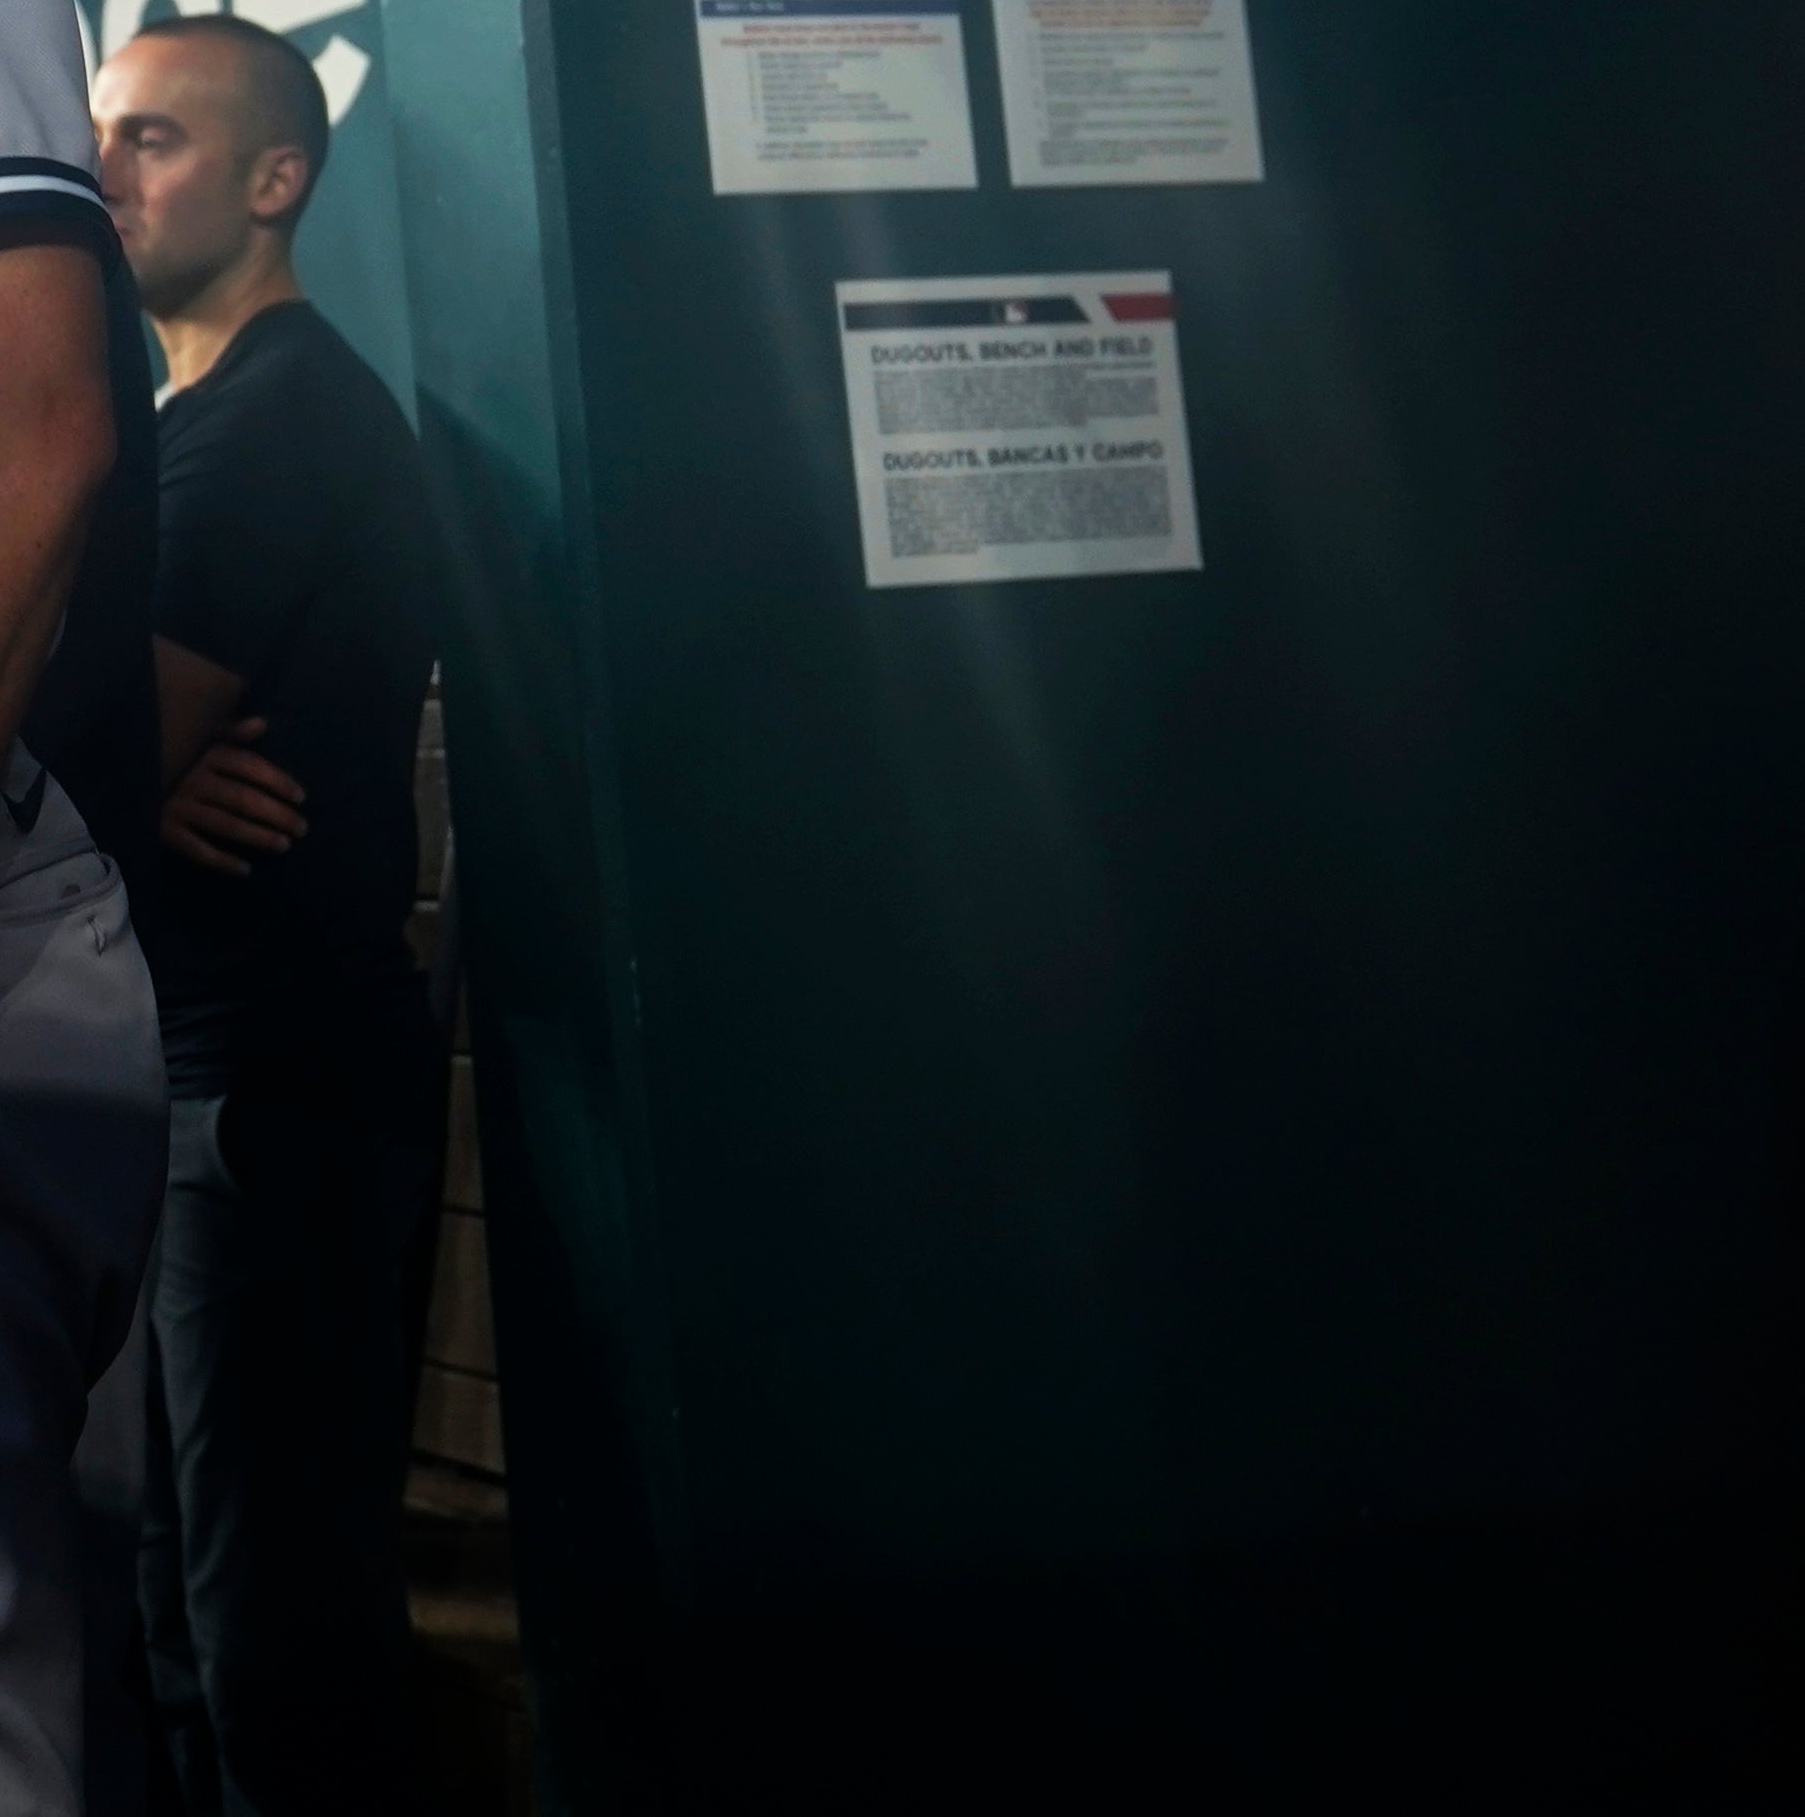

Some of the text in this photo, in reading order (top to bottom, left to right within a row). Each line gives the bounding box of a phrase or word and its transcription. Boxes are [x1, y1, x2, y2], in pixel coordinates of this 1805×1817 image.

[978, 340, 1046, 361] BENCH
[1054, 337, 1093, 359] AND
[1100, 335, 1154, 357] FIELD
[987, 444, 1070, 466] BANCAS
[1075, 443, 1086, 463] Y
[1091, 440, 1165, 463] CAMPO
